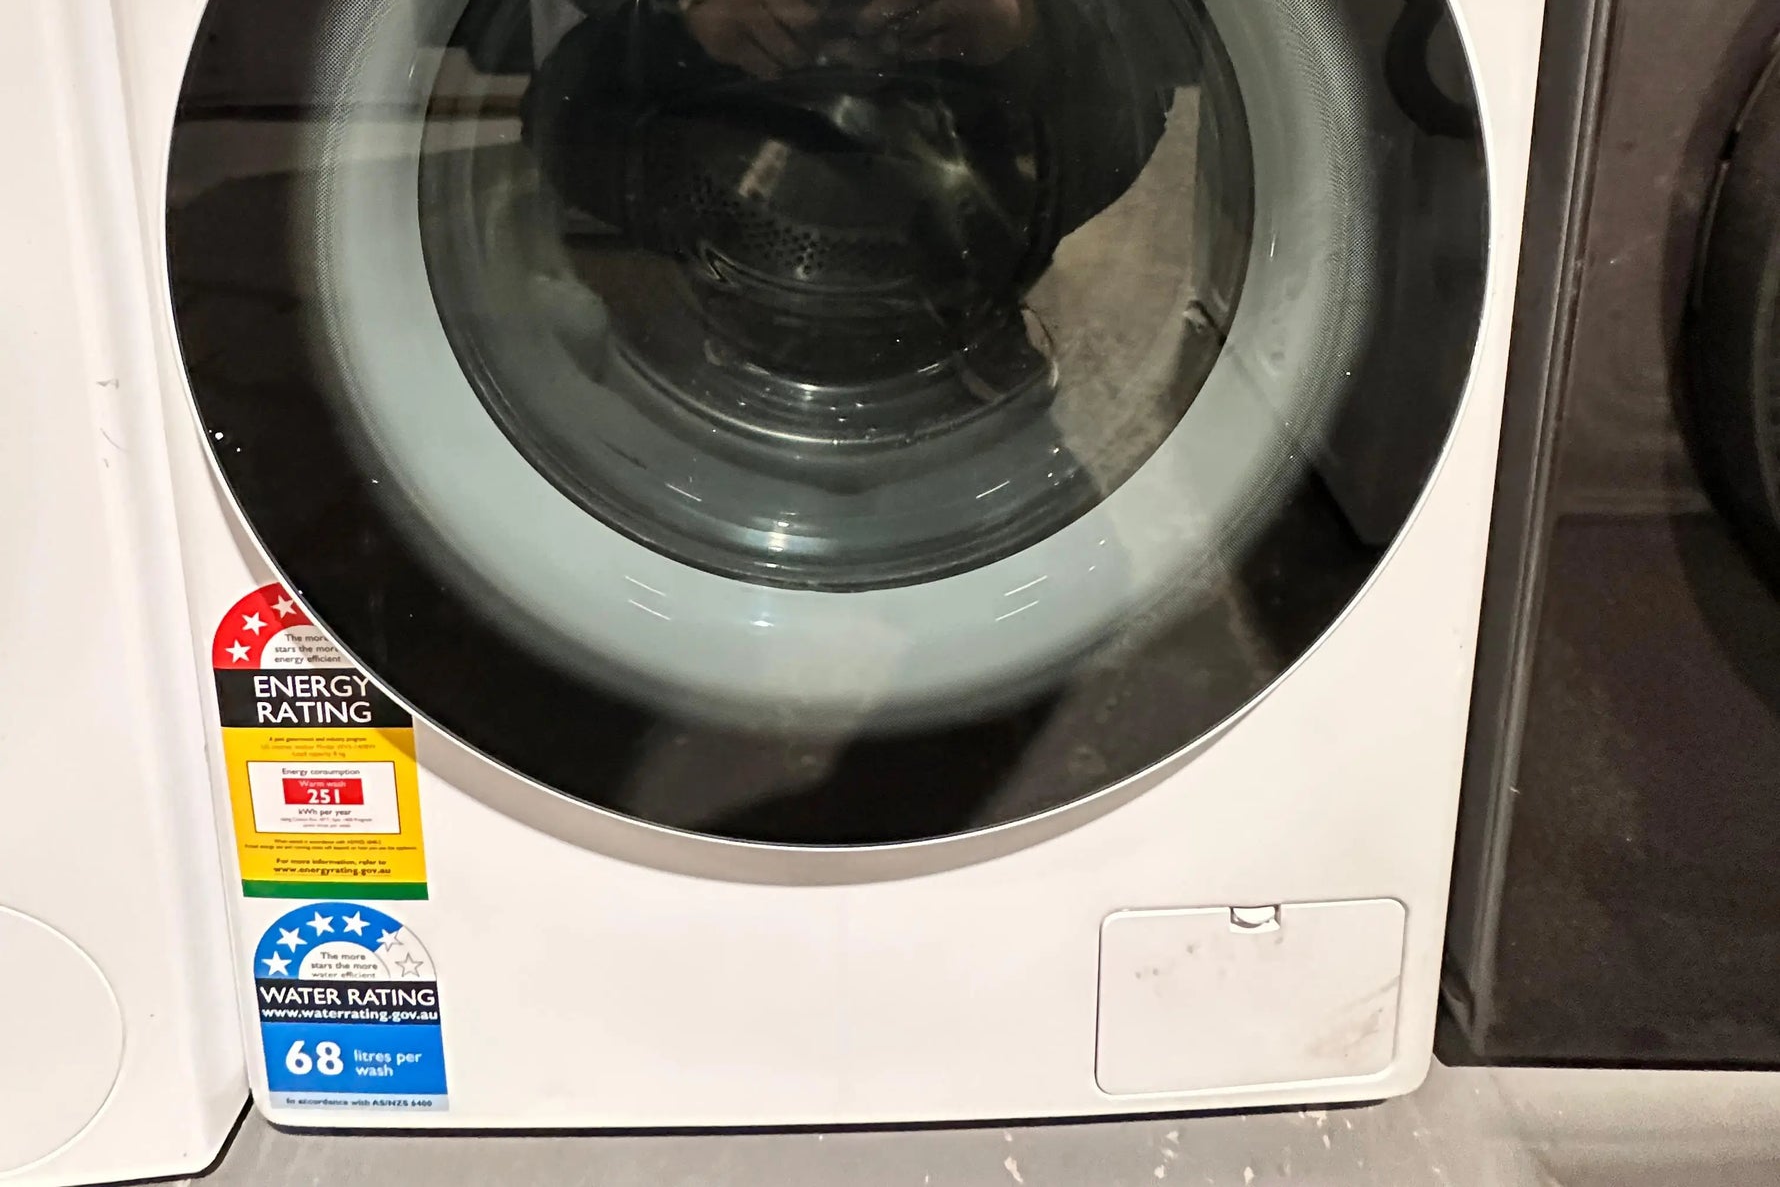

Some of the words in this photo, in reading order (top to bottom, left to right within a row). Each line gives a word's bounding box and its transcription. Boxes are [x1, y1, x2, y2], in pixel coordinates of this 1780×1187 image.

[285, 634, 302, 642] The
[274, 656, 304, 664] energy
[307, 655, 341, 663] efficient
[253, 675, 370, 698] ENERGY
[256, 701, 372, 724] RATING
[282, 768, 308, 777] Energy
[310, 769, 360, 777] consumption
[307, 789, 340, 804] 251
[274, 867, 391, 876] www.energyrating.gov.au
[320, 952, 338, 960] The
[311, 962, 333, 970] stars
[335, 962, 350, 970] the
[341, 971, 375, 979] efficient
[260, 986, 341, 1006] WATER
[348, 988, 435, 1007] RATING
[261, 1007, 438, 1023] www.waterrating.gov.au
[285, 1040, 344, 1076] 68
[353, 1049, 392, 1063] litres
[396, 1051, 422, 1066] per
[355, 1064, 394, 1077] wash
